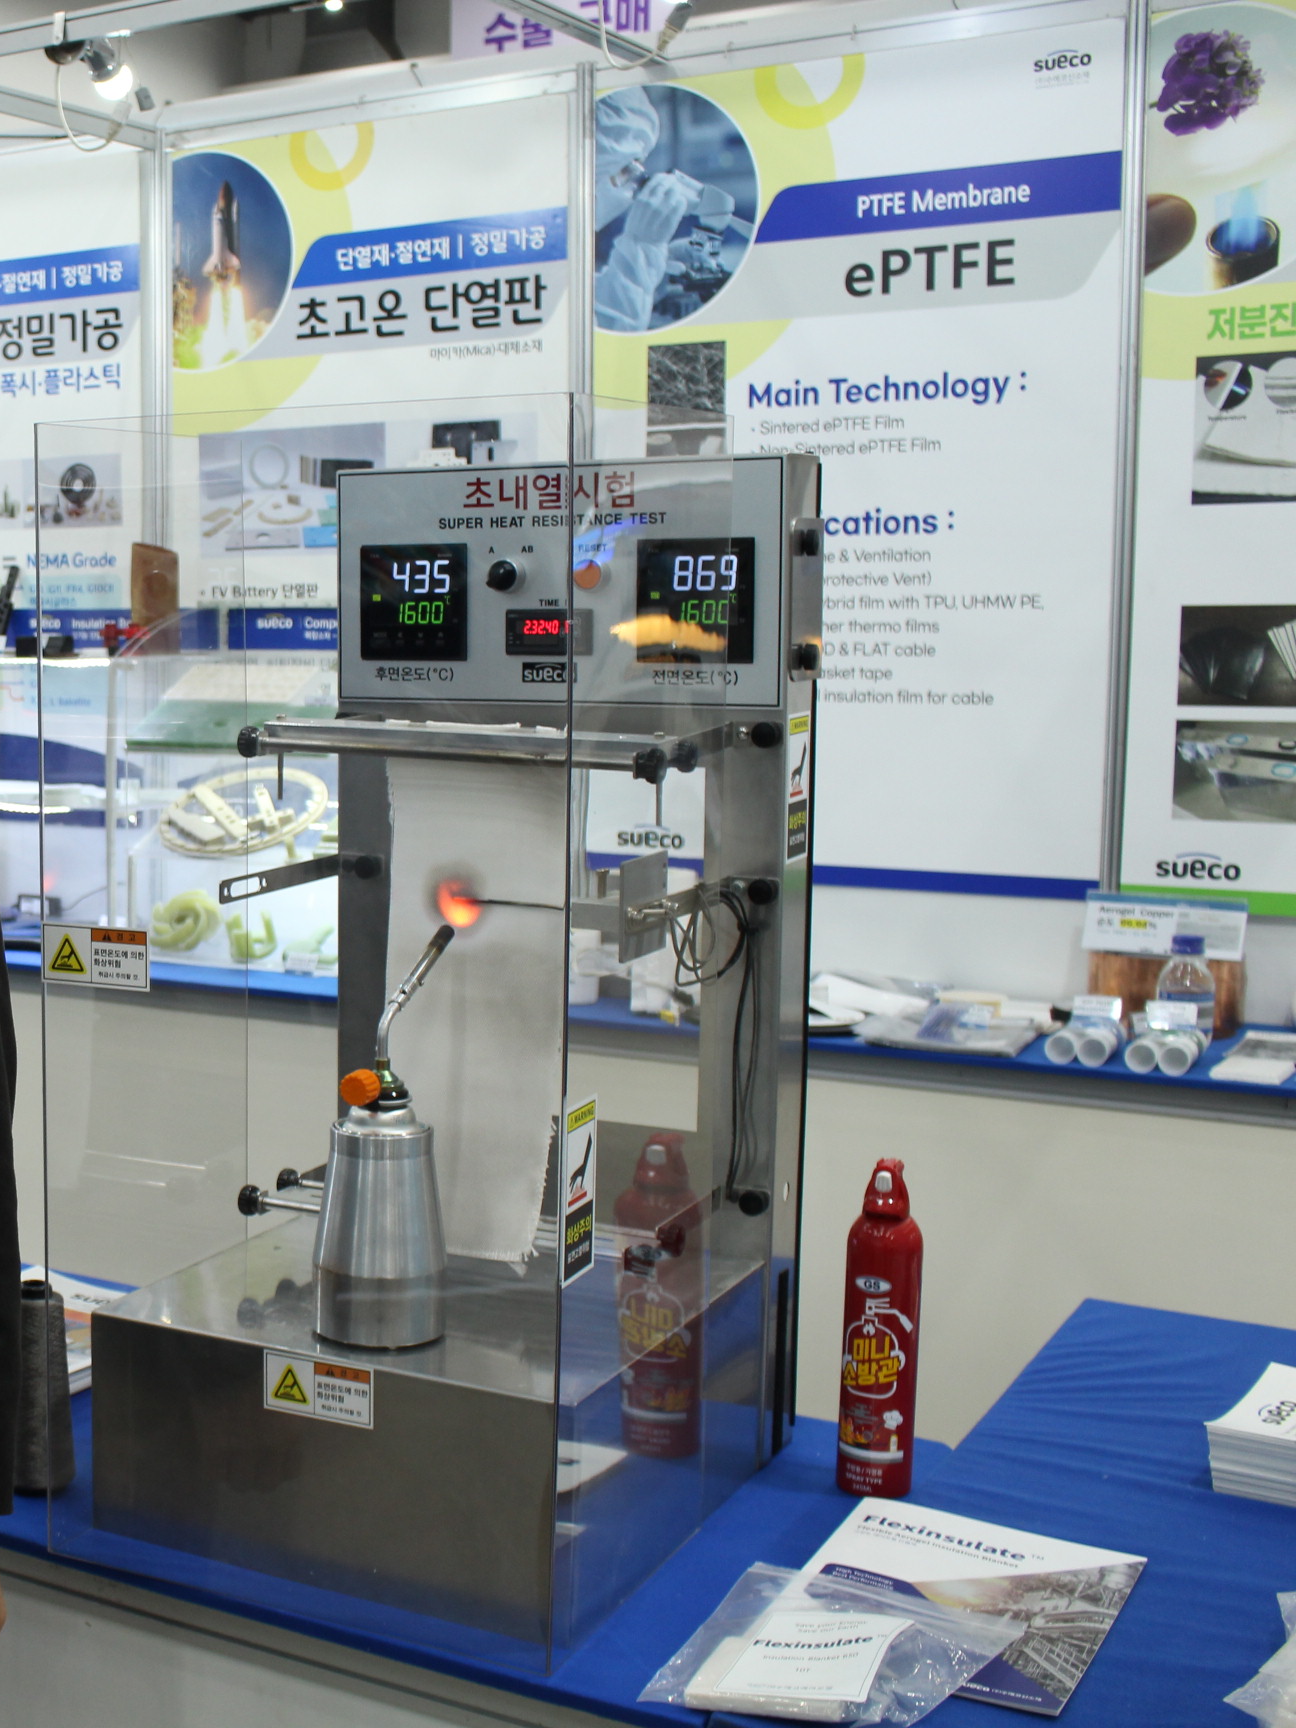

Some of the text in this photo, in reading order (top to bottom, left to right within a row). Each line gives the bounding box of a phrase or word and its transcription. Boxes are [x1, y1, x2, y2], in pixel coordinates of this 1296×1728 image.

[1033, 52, 1092, 73] sueco
[856, 182, 1031, 219] PTFE Membrane
[471, 226, 547, 257] 정밀가공
[61, 260, 124, 288] 정밀가공
[844, 238, 1016, 298] ePTFE
[296, 273, 548, 341] 초고온 단열판
[748, 381, 820, 409] Main
[828, 371, 1011, 405] Technology
[760, 415, 905, 436] Sintered ePTFE Film
[859, 438, 907, 455] ePTFE
[911, 437, 942, 453] Film
[439, 516, 483, 530] SUPER
[489, 515, 525, 529] HEAT
[629, 512, 666, 526] TEST
[824, 507, 939, 537] cations
[488, 545, 495, 554] A
[521, 545, 534, 554] AB
[854, 548, 932, 563] Ventilation
[73, 552, 117, 568] Grade
[393, 559, 451, 593] 435
[673, 555, 738, 592] 869
[893, 571, 933, 587] Vent)
[282, 583, 319, 599] 단열판
[538, 599, 560, 607] TIME
[860, 595, 884, 610] film
[889, 595, 920, 611] with
[962, 593, 1016, 610] UHMW
[256, 616, 294, 630] sueco
[399, 601, 444, 625] 1600
[848, 618, 940, 634] thermo films
[854, 642, 891, 657] FLAT
[894, 642, 937, 658] cable
[860, 668, 894, 684] tape
[824, 688, 995, 706] insulation film for cable
[617, 830, 684, 850] sueco
[1156, 857, 1242, 881] sueco
[863, 1278, 881, 1292] GS
[853, 1335, 891, 1361] 미니
[843, 1357, 902, 1387] 소방관
[863, 1514, 1027, 1562] Flexinsulate
[753, 1635, 874, 1650] Flexinsulate
